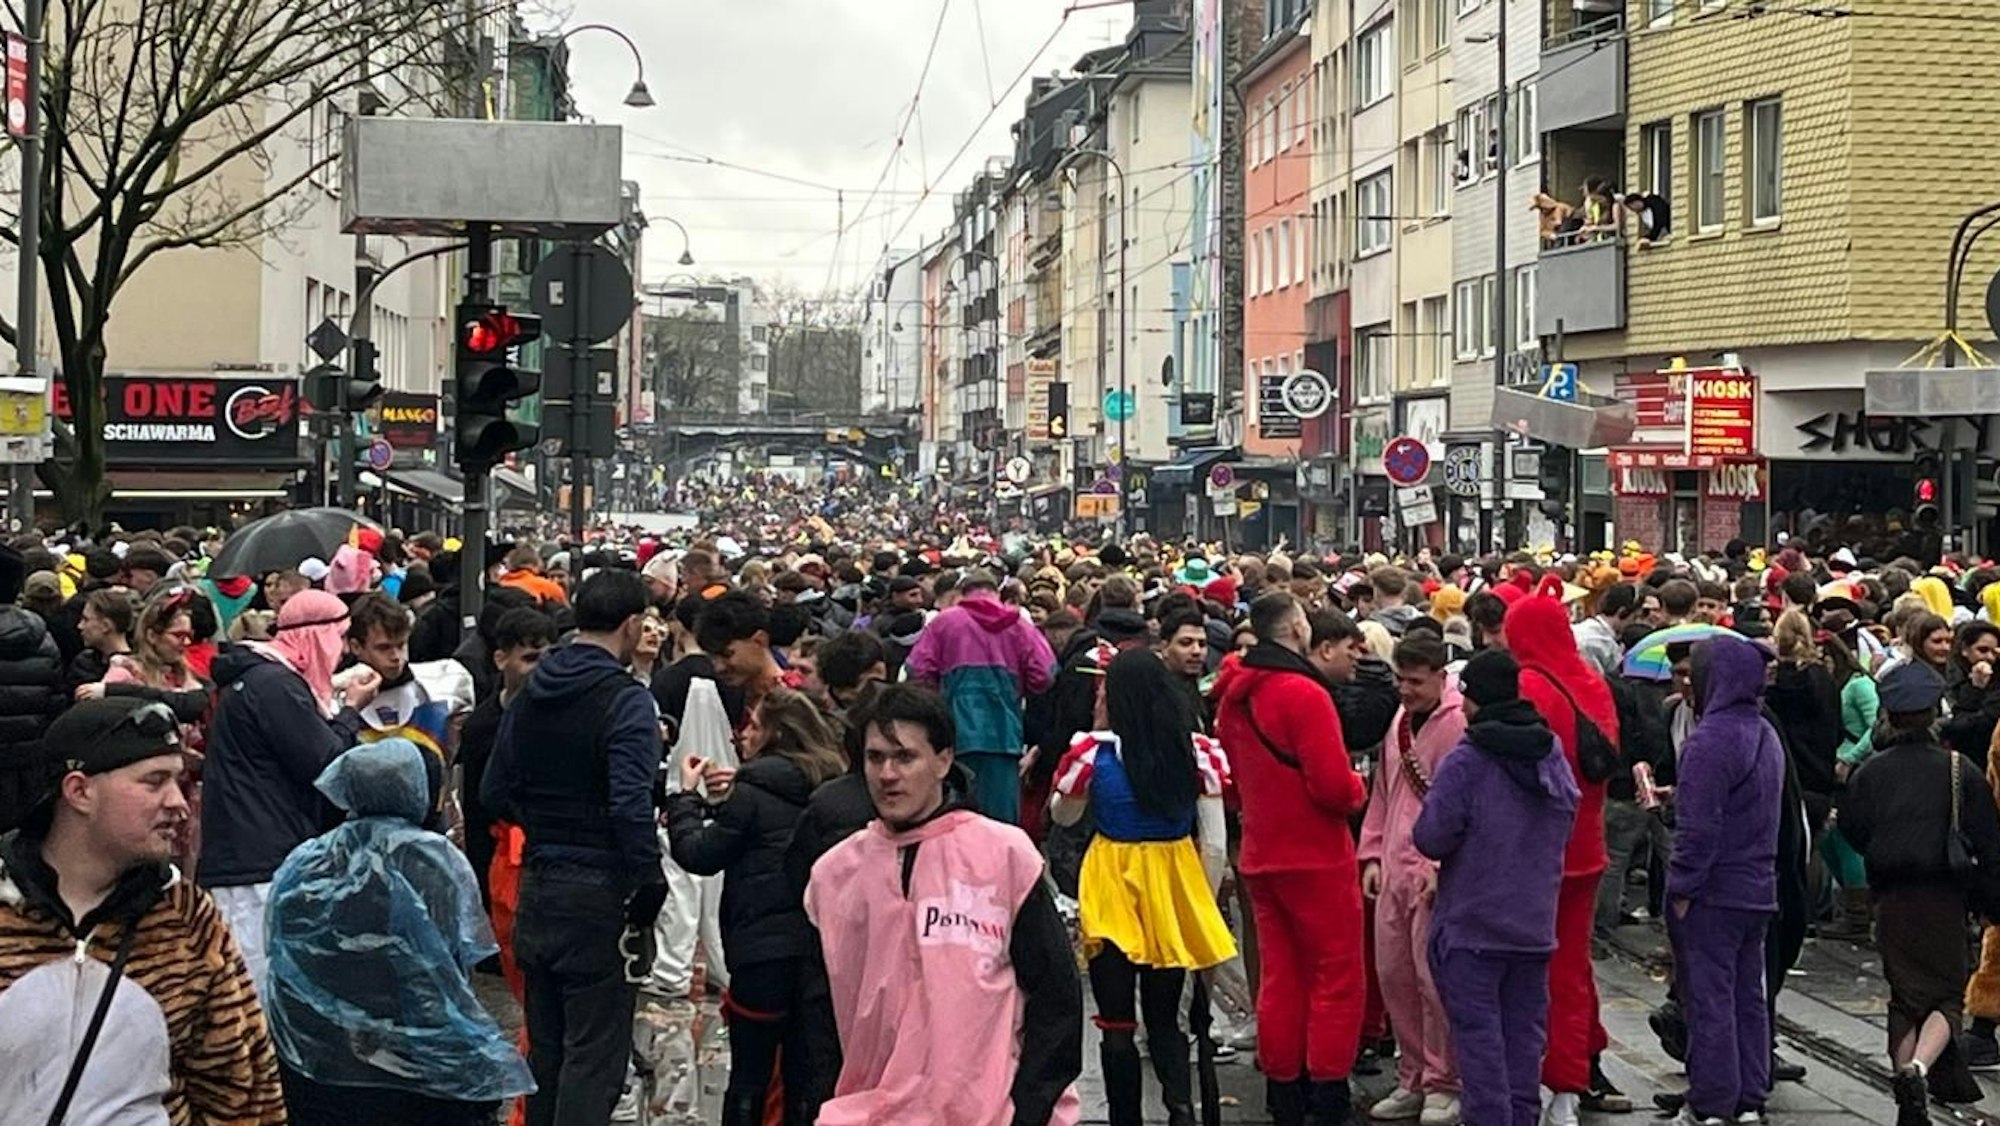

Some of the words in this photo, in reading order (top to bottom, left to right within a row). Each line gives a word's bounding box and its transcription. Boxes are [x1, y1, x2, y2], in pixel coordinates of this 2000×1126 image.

[124, 384, 216, 417] ONE
[1693, 379, 1752, 399] KIOSK
[103, 424, 216, 441] SCHAWARMA
[1795, 409, 1990, 453] SHORY
[1621, 466, 1668, 494] KIOSK
[1708, 464, 1760, 498] KIOSK
